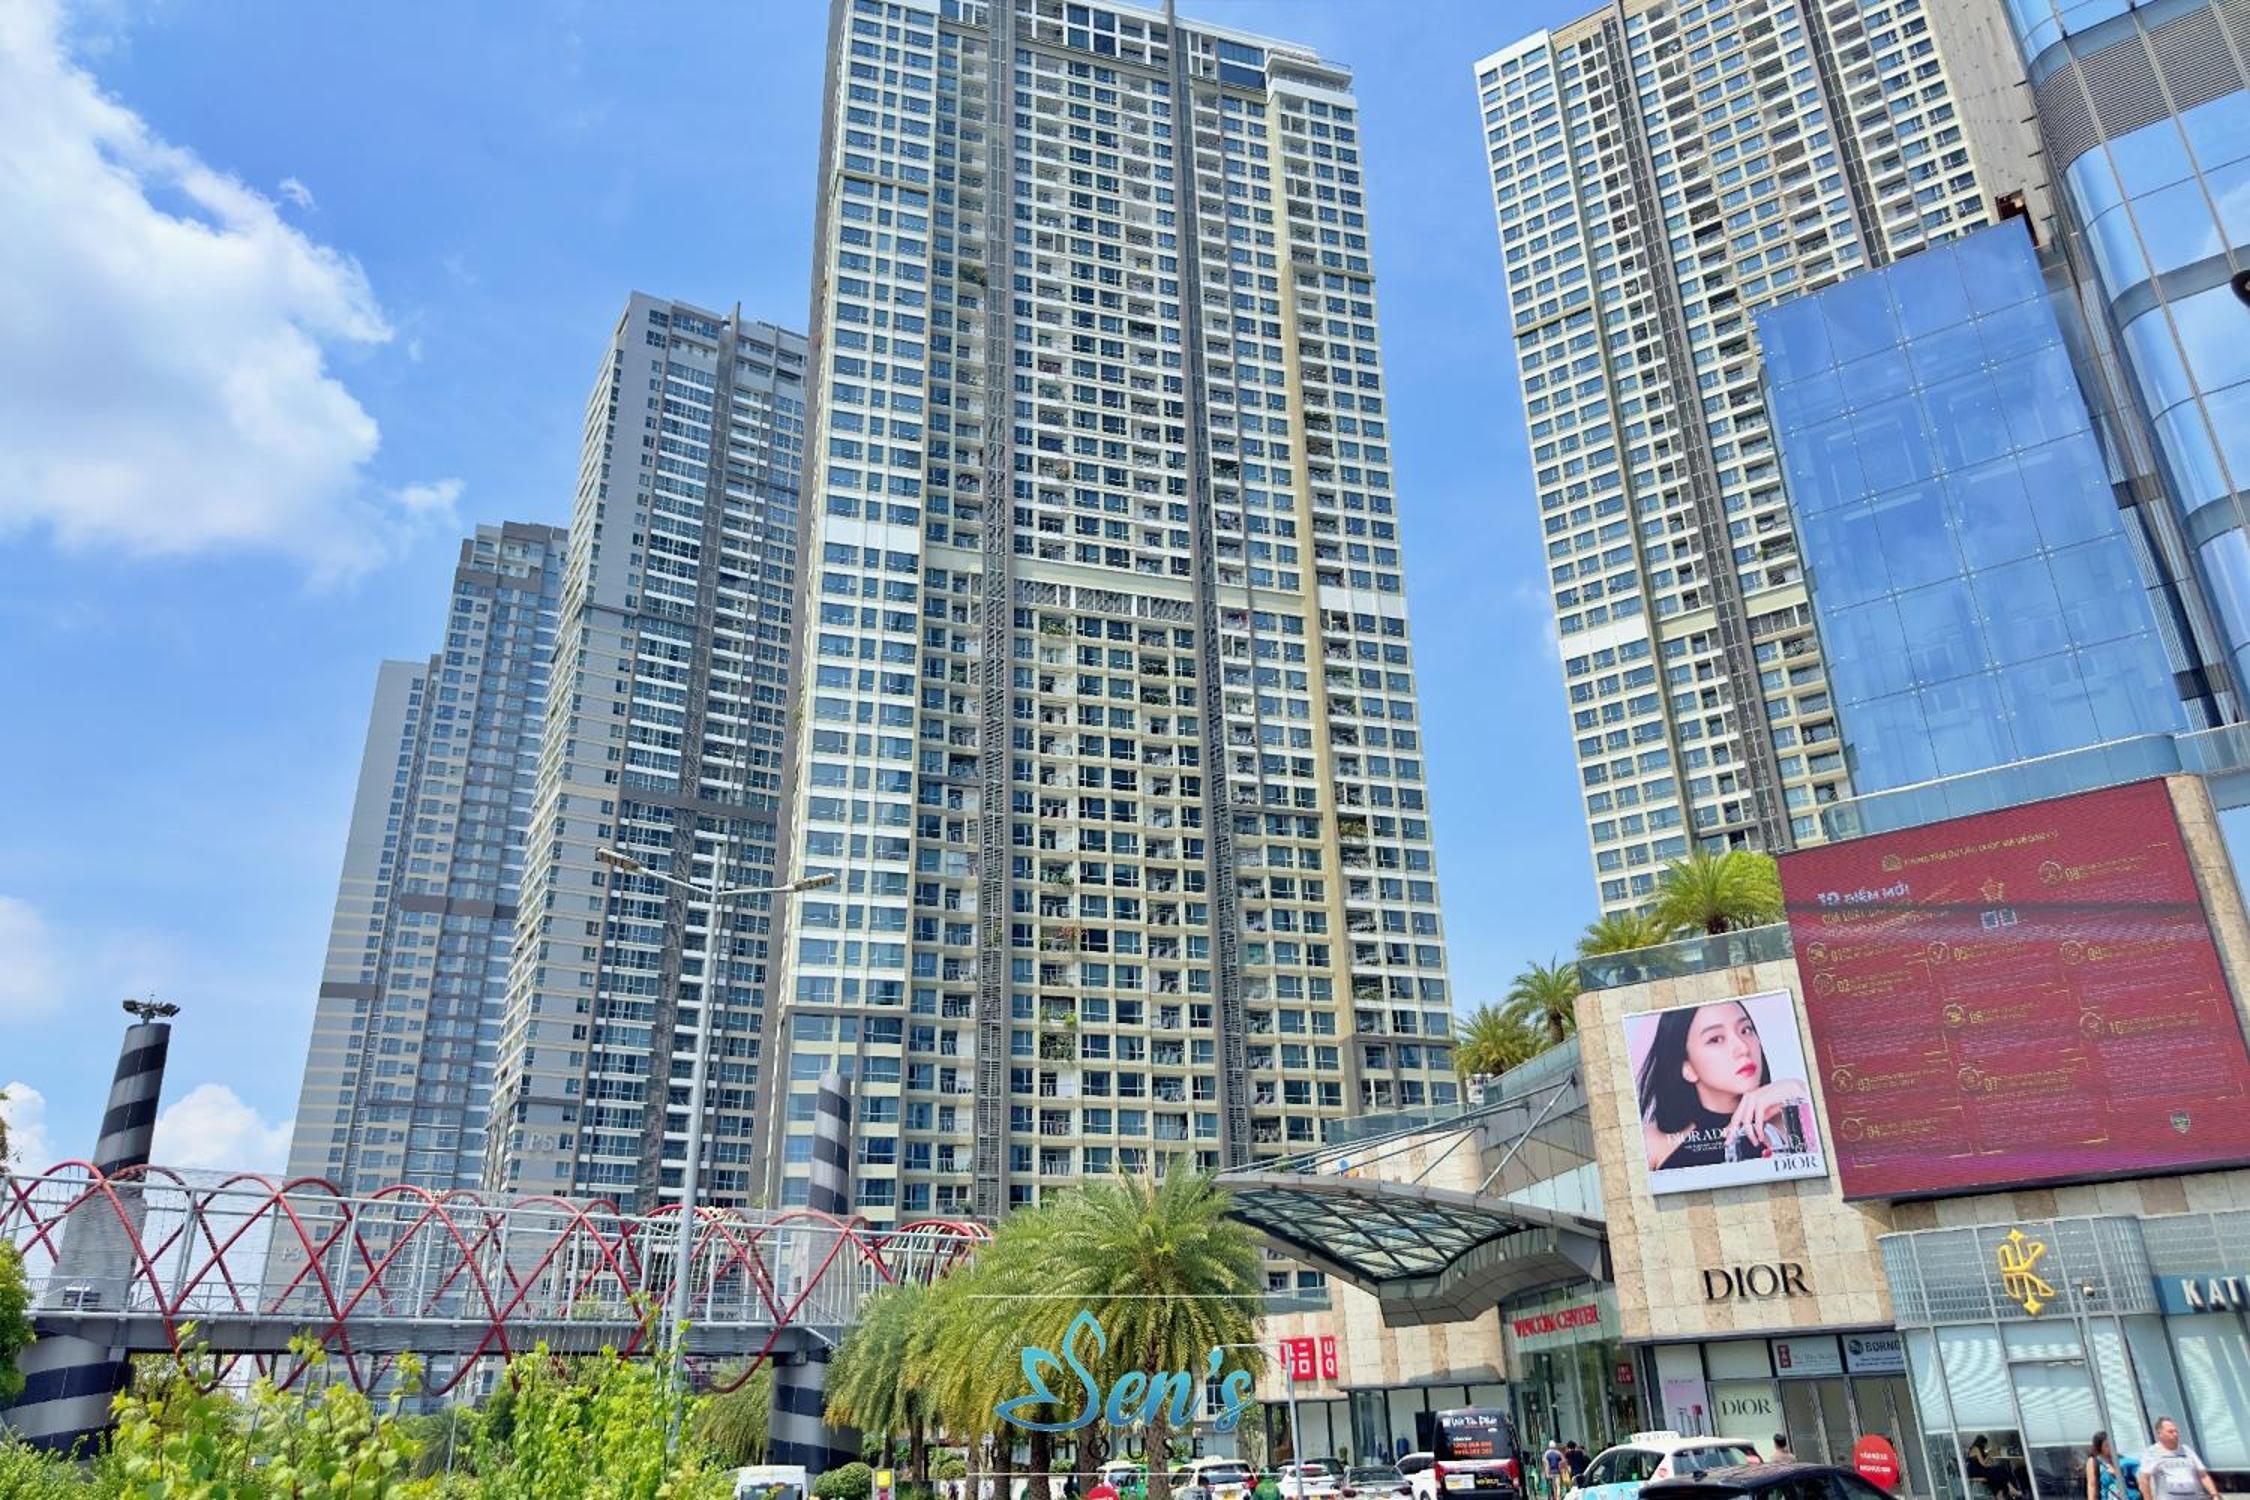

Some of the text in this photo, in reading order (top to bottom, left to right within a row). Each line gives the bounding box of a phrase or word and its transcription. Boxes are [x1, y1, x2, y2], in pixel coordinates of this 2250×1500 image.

[1774, 1155, 1818, 1173] DIOR
[1703, 1262, 1813, 1301] DIOR
[1721, 1398, 1773, 1417] DIOR
